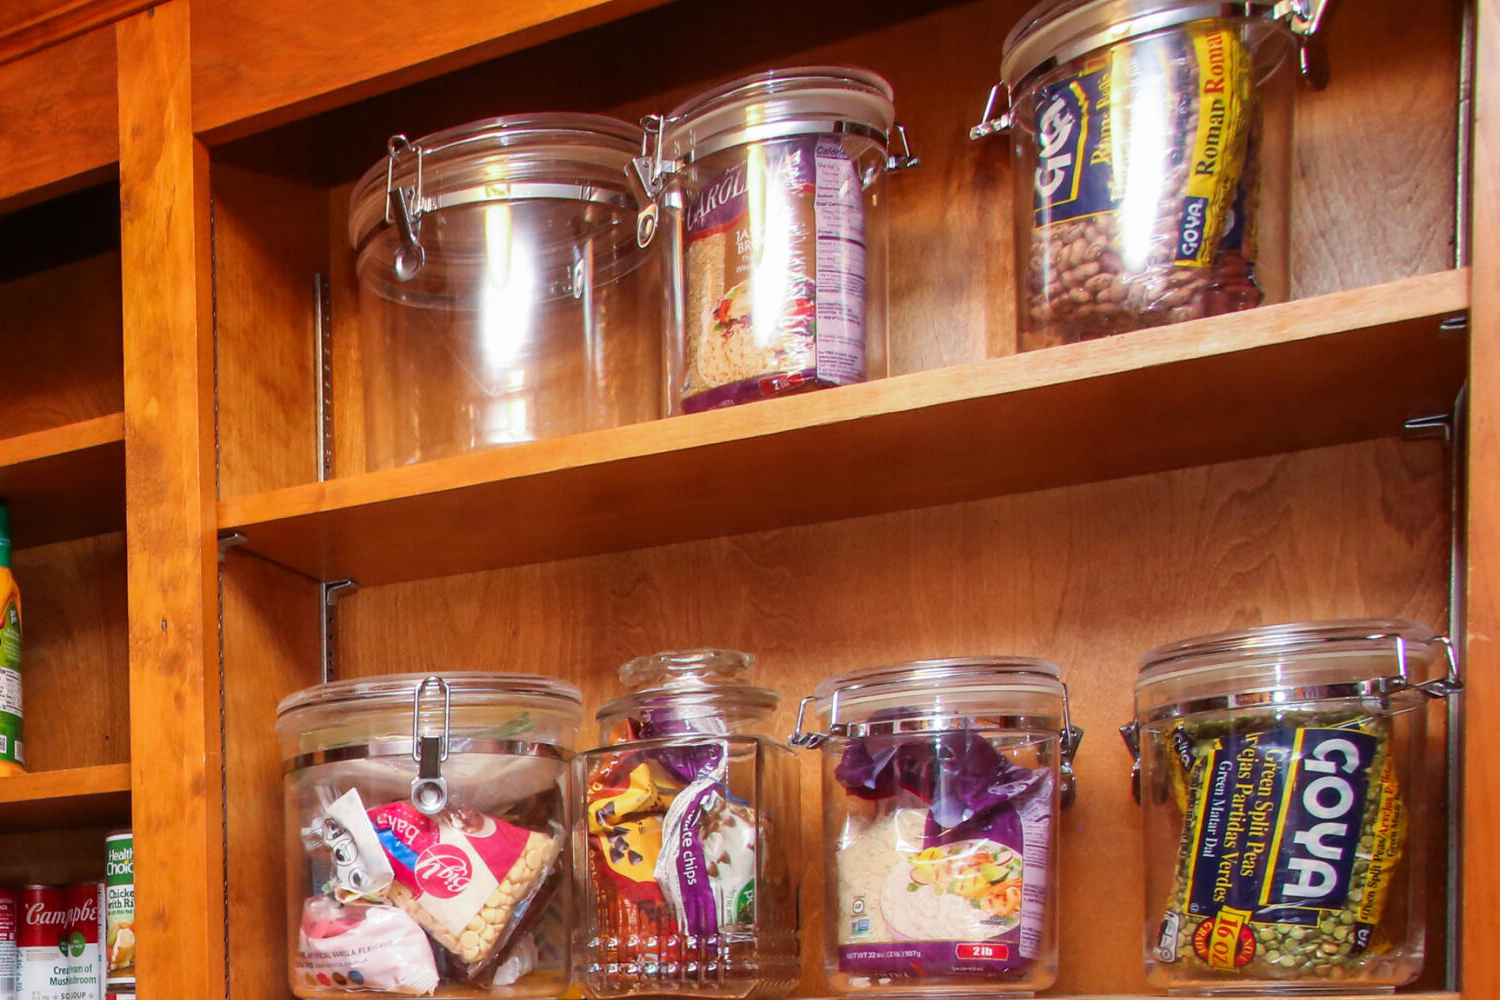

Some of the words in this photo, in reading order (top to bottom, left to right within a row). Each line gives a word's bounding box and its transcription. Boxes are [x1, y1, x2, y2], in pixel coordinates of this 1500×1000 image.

[687, 166, 749, 231] CAROL
[1181, 199, 1203, 256] GOYA
[1214, 760, 1233, 796] Green
[1258, 748, 1286, 797] Green
[1207, 798, 1224, 835] Matar
[1223, 783, 1255, 848] Partidas
[1247, 800, 1275, 837] Split
[1281, 738, 1361, 898] GOYA
[682, 850, 698, 886] chips
[1212, 851, 1240, 903] Verdes
[1240, 842, 1266, 877] Peas
[1217, 916, 1239, 939] 16
[972, 946, 981, 956] 2
[981, 946, 993, 956] lb
